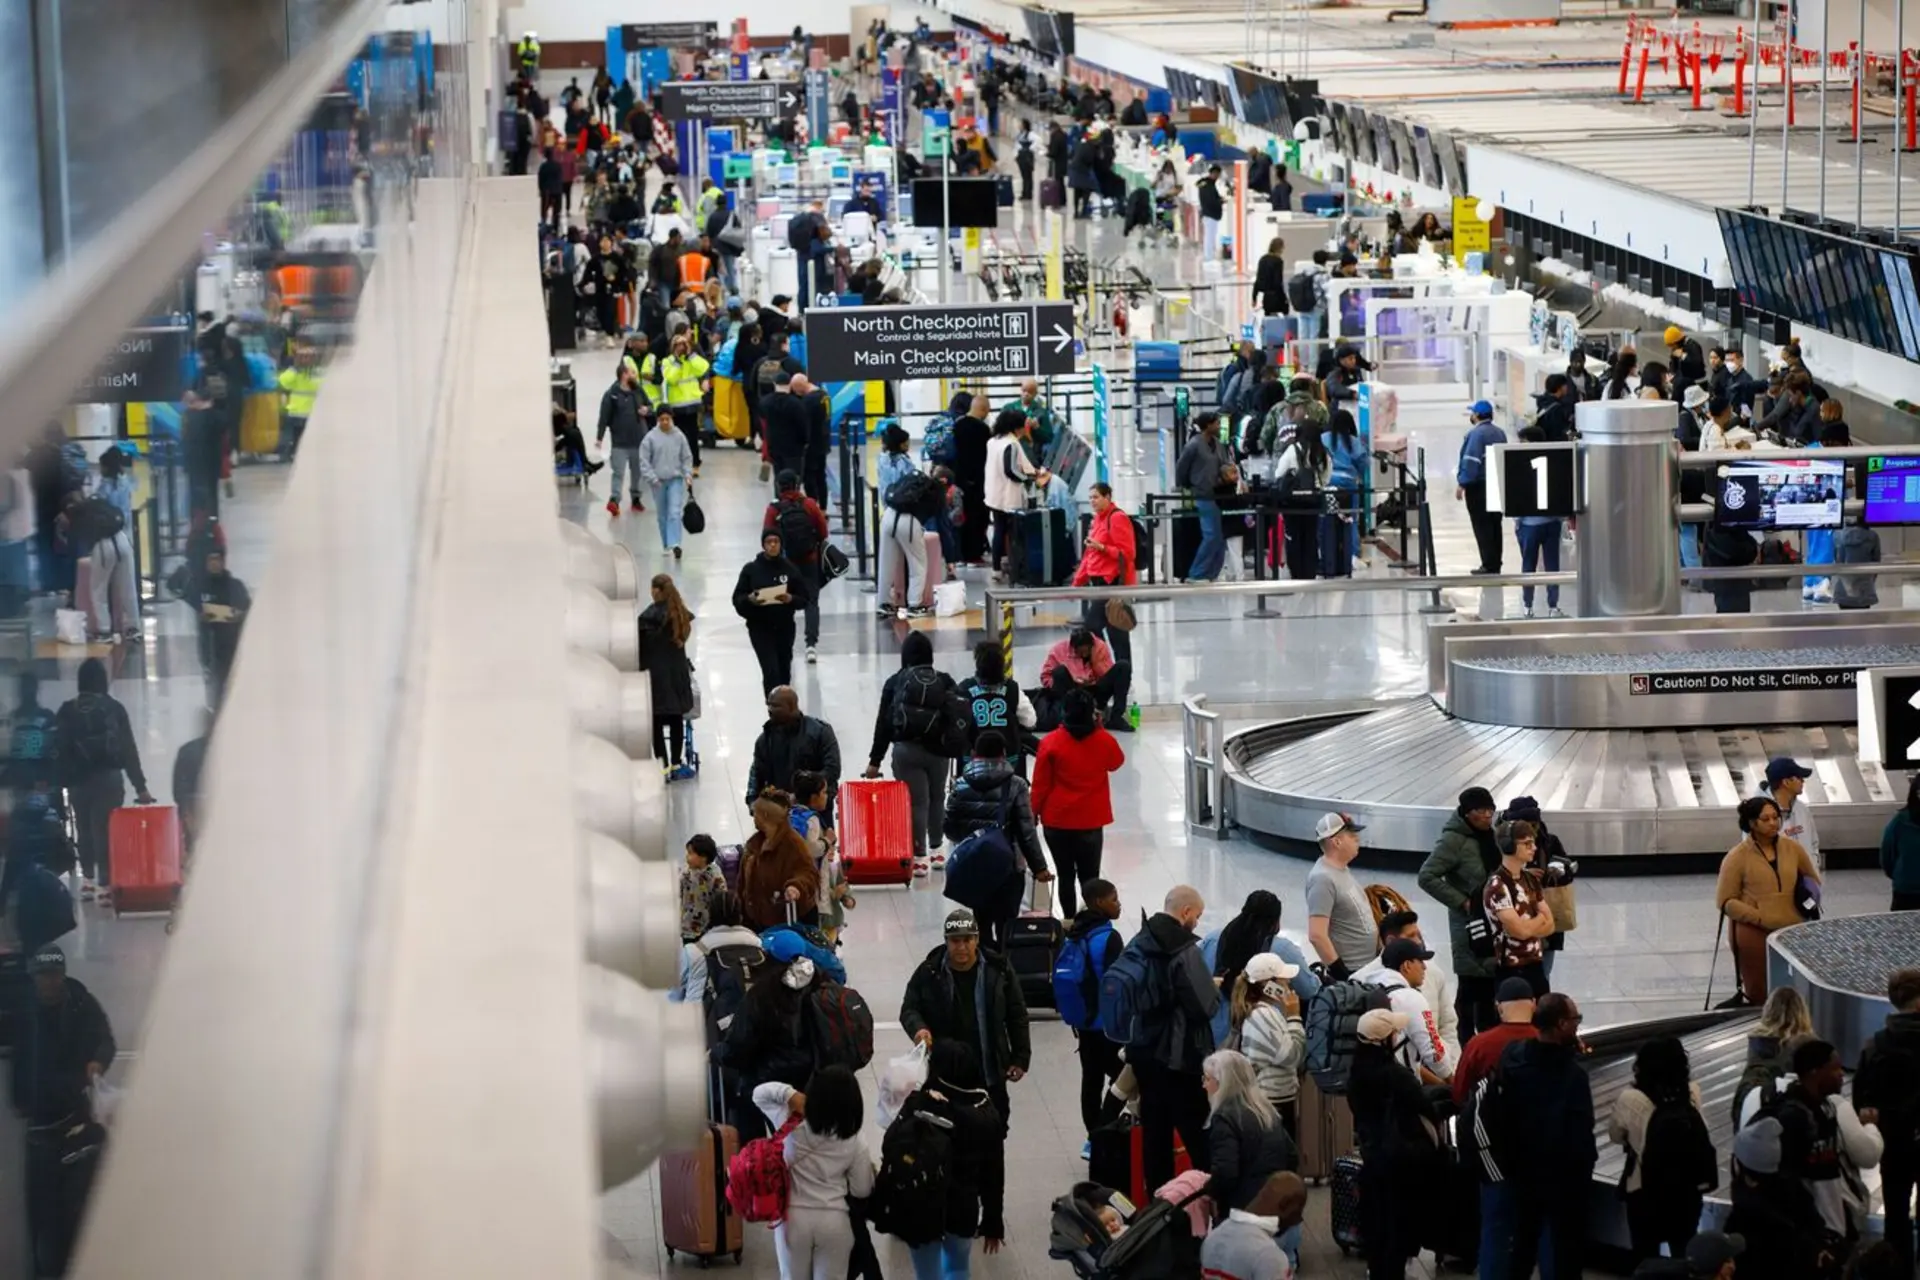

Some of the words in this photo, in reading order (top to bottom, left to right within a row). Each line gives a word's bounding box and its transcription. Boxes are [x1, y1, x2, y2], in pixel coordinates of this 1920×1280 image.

[844, 316, 894, 333] North
[900, 313, 1000, 332] Checkpoint
[877, 333, 911, 342] Control
[912, 333, 924, 342] de
[928, 332, 973, 342] Seguridad
[975, 331, 1001, 340] Norte
[854, 350, 895, 366] Main
[901, 347, 1001, 365] Checkpoint
[906, 365, 940, 375] Control
[942, 365, 954, 374] de
[956, 364, 1001, 375] Seguridad
[1530, 455, 1548, 510] 1
[1654, 676, 1707, 690] Caution!
[1711, 675, 1728, 688] Do
[1732, 674, 1755, 687] Not
[1758, 673, 1779, 688] Sit,
[1782, 672, 1822, 687] Climb,
[1826, 674, 1839, 684] or
[972, 697, 1008, 727] 82
